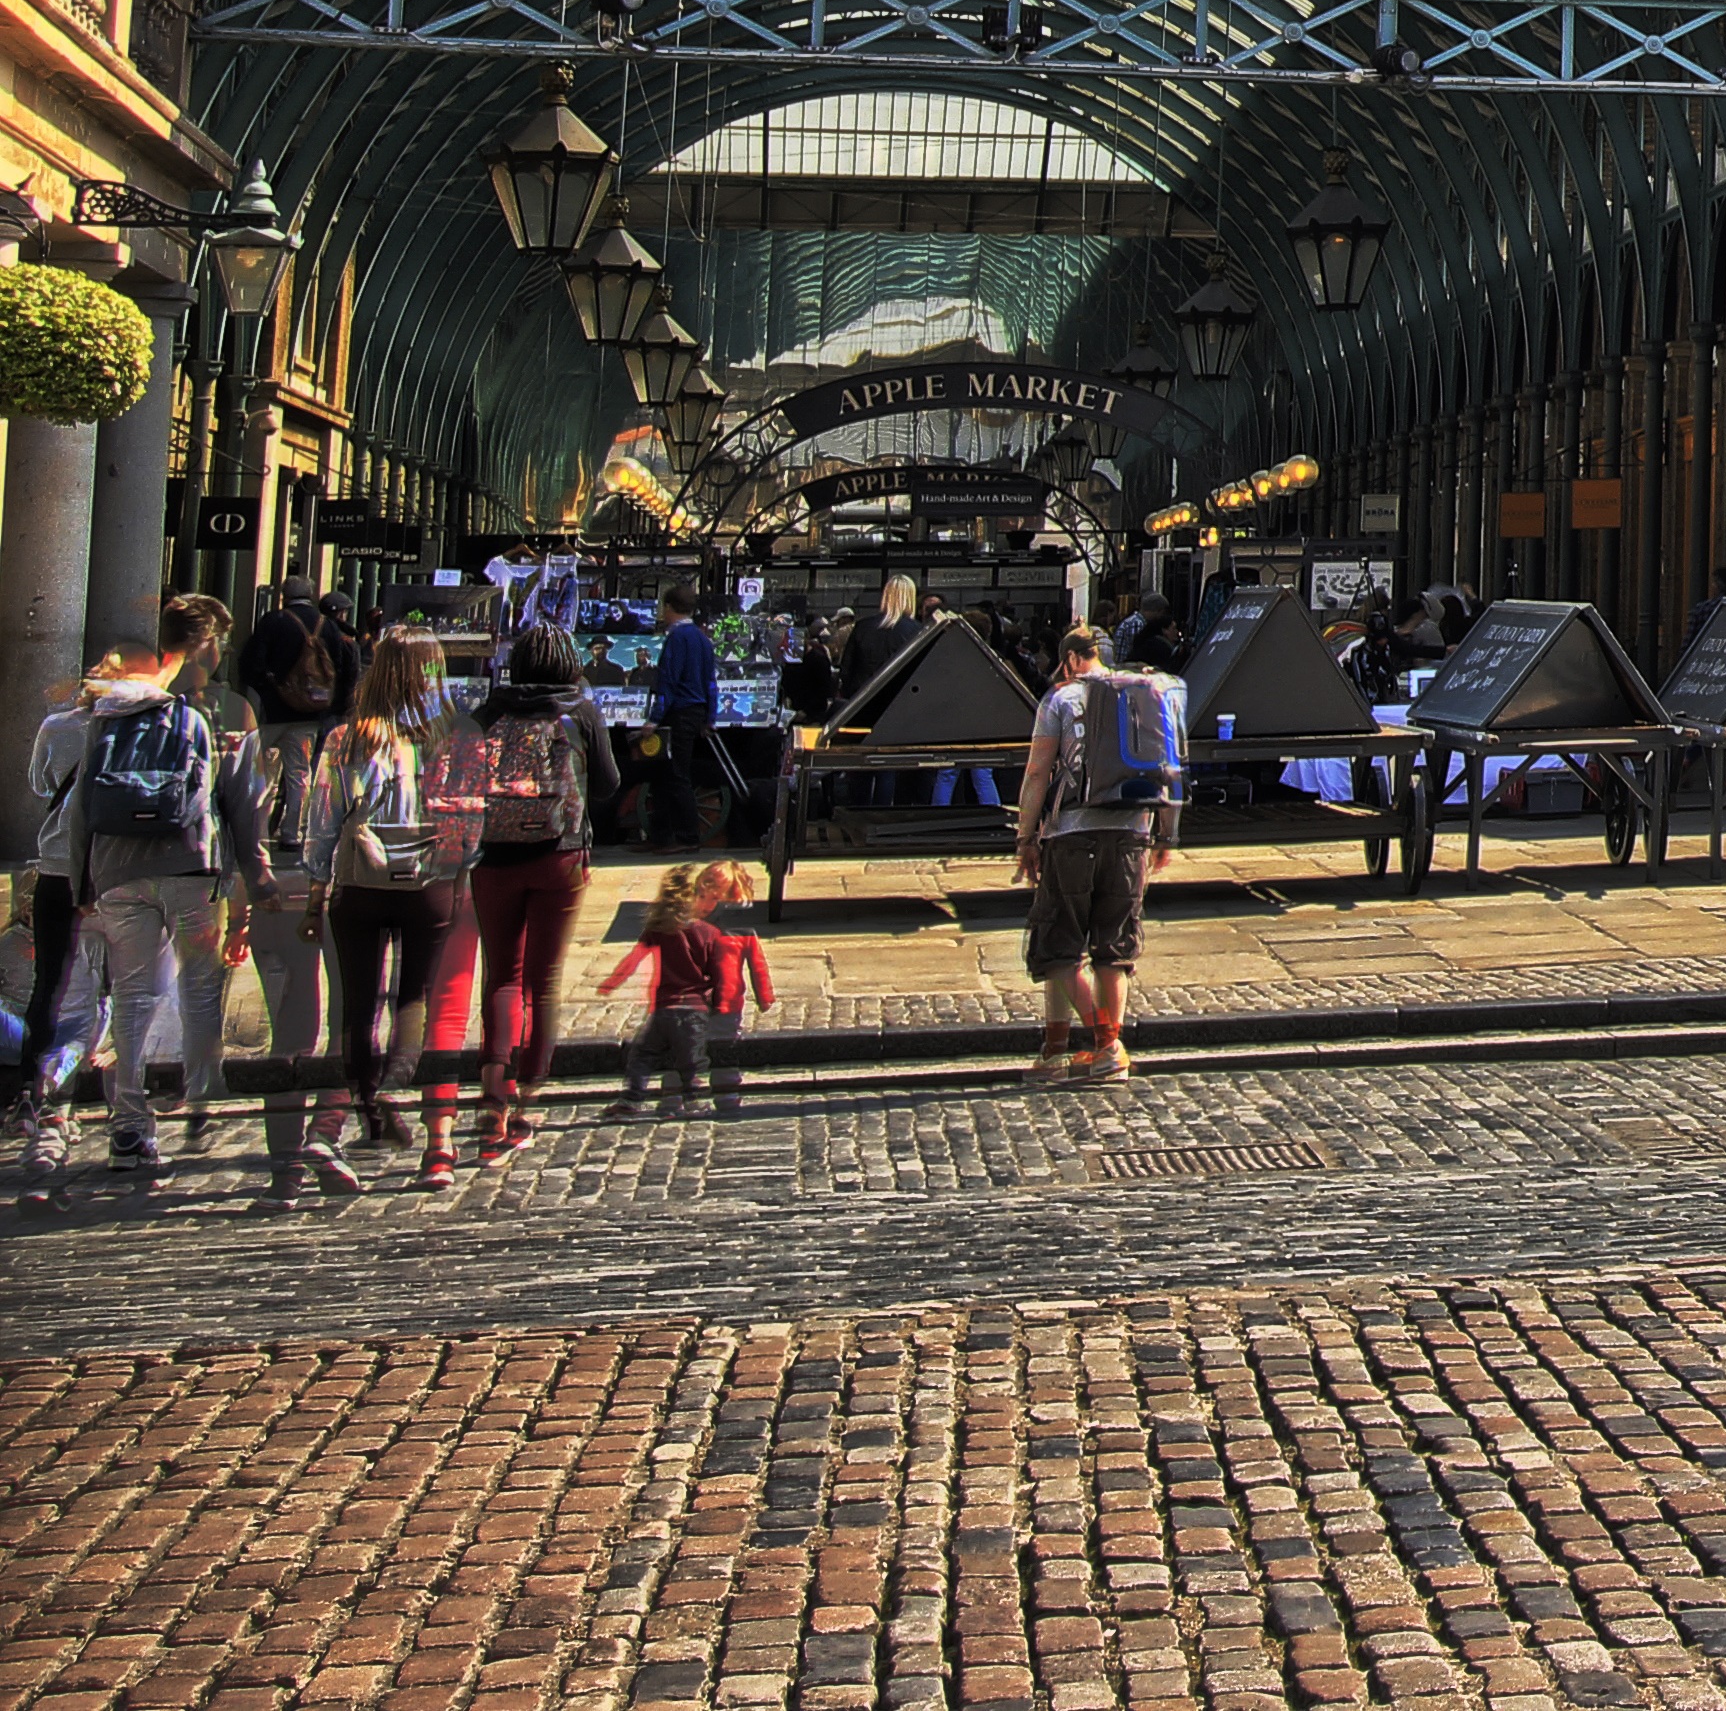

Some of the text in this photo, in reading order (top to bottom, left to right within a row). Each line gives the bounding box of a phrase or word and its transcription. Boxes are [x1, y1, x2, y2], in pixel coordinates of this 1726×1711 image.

[838, 371, 1124, 416] APPLE MARKET
[835, 471, 909, 499] APPLE
[920, 493, 1034, 506] Hand-made Art & Design
[319, 514, 364, 524] LINKS
[340, 547, 384, 557] CASIO
